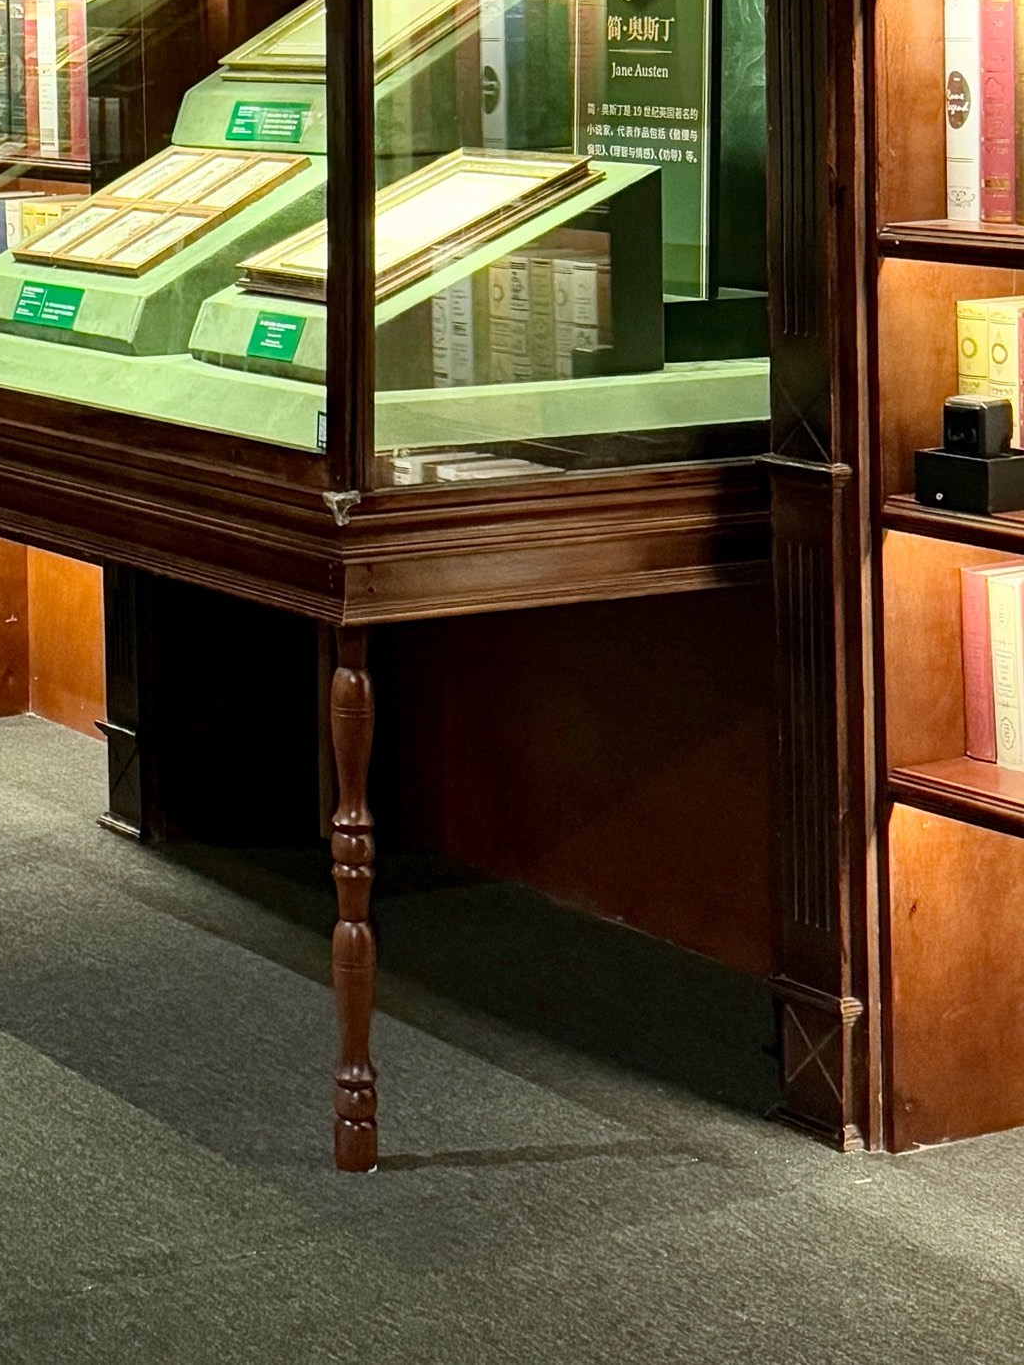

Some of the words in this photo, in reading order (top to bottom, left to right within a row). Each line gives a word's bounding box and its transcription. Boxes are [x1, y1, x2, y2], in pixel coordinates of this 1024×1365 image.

[607, 15, 675, 42] 简·奥斯丁
[612, 62, 633, 78] Jane
[634, 63, 669, 78] Austen
